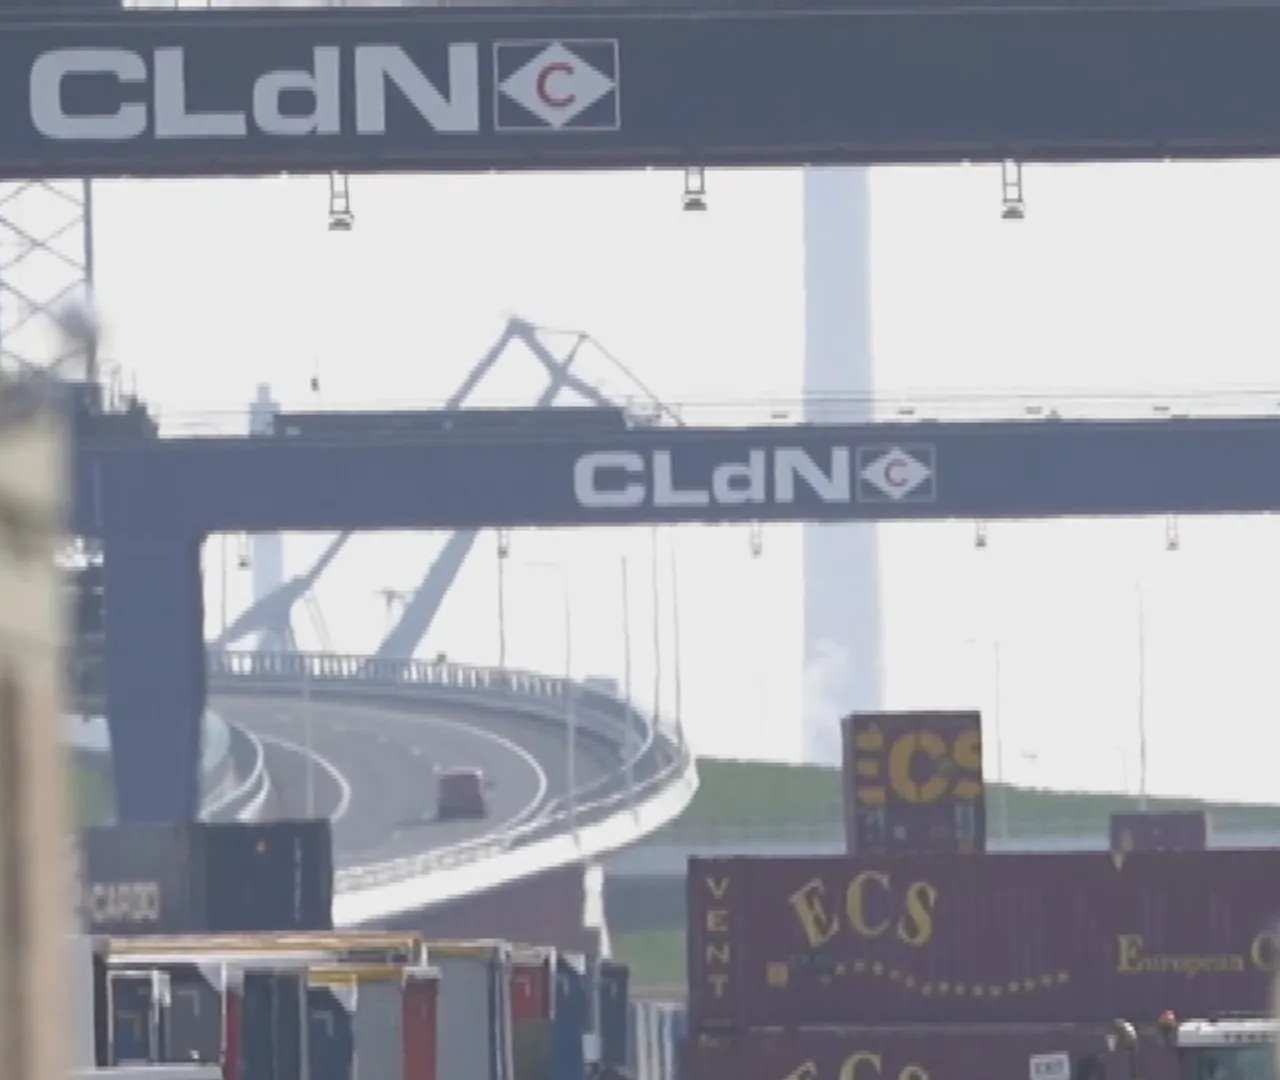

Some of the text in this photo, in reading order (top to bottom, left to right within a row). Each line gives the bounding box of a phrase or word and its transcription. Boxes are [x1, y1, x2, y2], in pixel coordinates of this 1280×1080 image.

[29, 42, 480, 140] CLdN
[574, 446, 851, 507] CLdN
[855, 727, 982, 804] ECS
[705, 877, 731, 999] VENT
[789, 870, 938, 948] ECS
[1116, 934, 1245, 977] European
